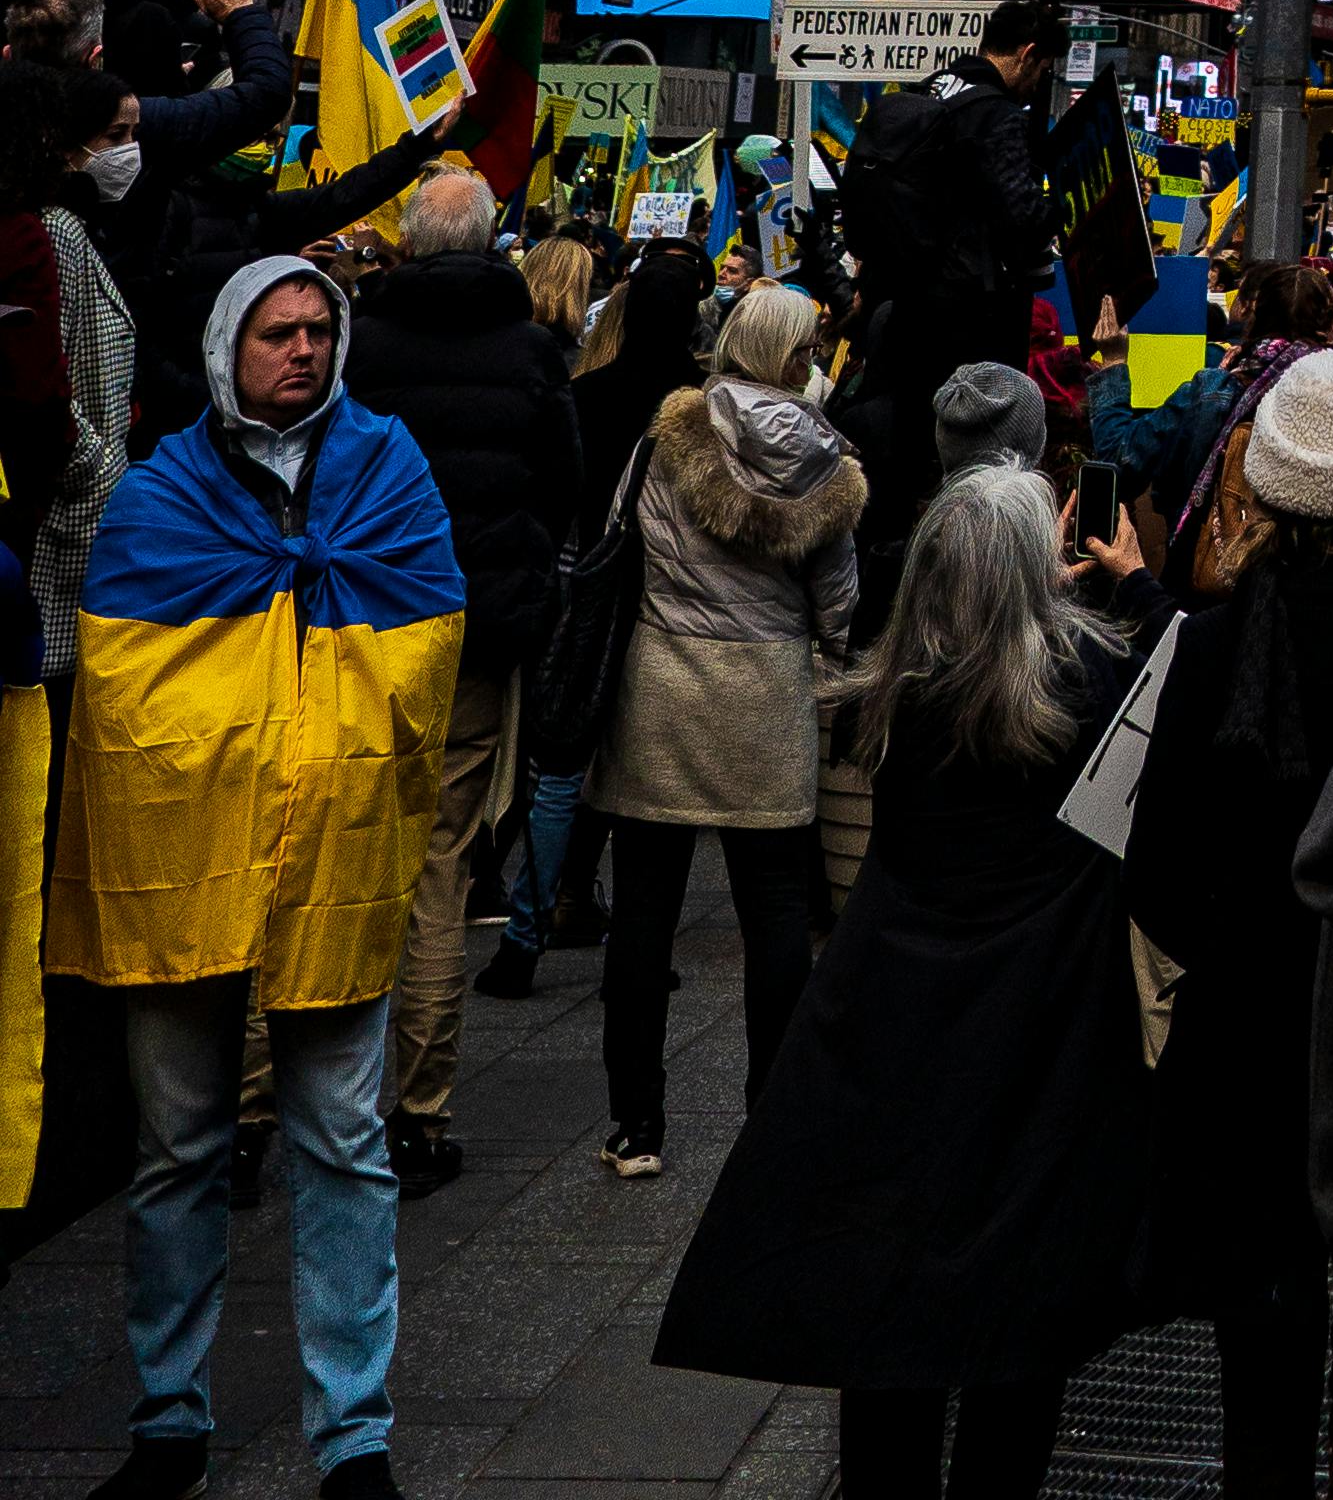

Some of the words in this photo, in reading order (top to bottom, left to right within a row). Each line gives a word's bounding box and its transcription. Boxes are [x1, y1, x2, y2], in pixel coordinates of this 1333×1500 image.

[792, 10, 901, 36] PEDESTRIAN
[906, 11, 955, 37] FLOW
[883, 45, 929, 70] KEEP
[1189, 97, 1233, 119] NATO
[1187, 118, 1231, 134] CLOSE
